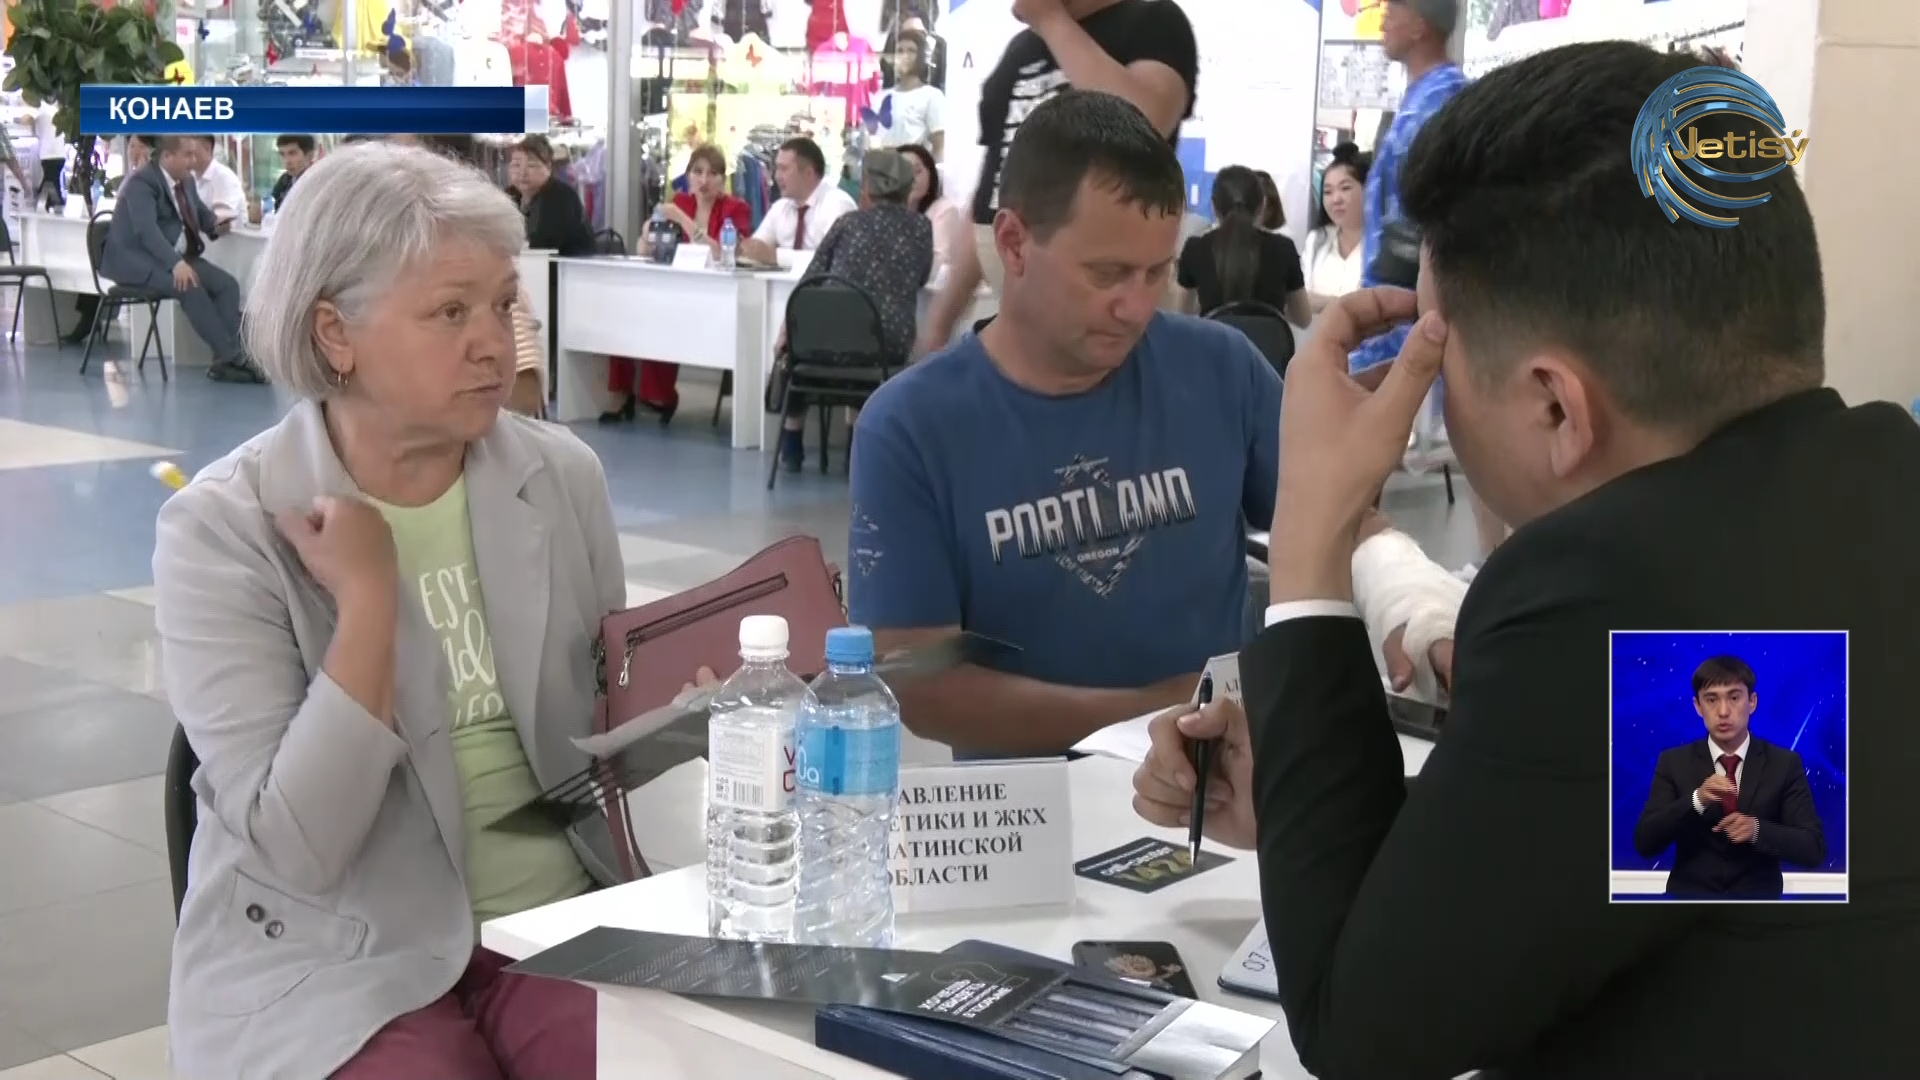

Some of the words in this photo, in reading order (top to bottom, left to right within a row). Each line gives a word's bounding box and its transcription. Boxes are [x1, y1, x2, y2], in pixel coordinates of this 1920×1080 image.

[984, 466, 1197, 564] PORTLAND
[1076, 547, 1121, 565] OREGON
[898, 783, 1008, 805] АВЛЕНИЕ
[973, 811, 988, 829] И
[994, 807, 1047, 828] ЖКХ
